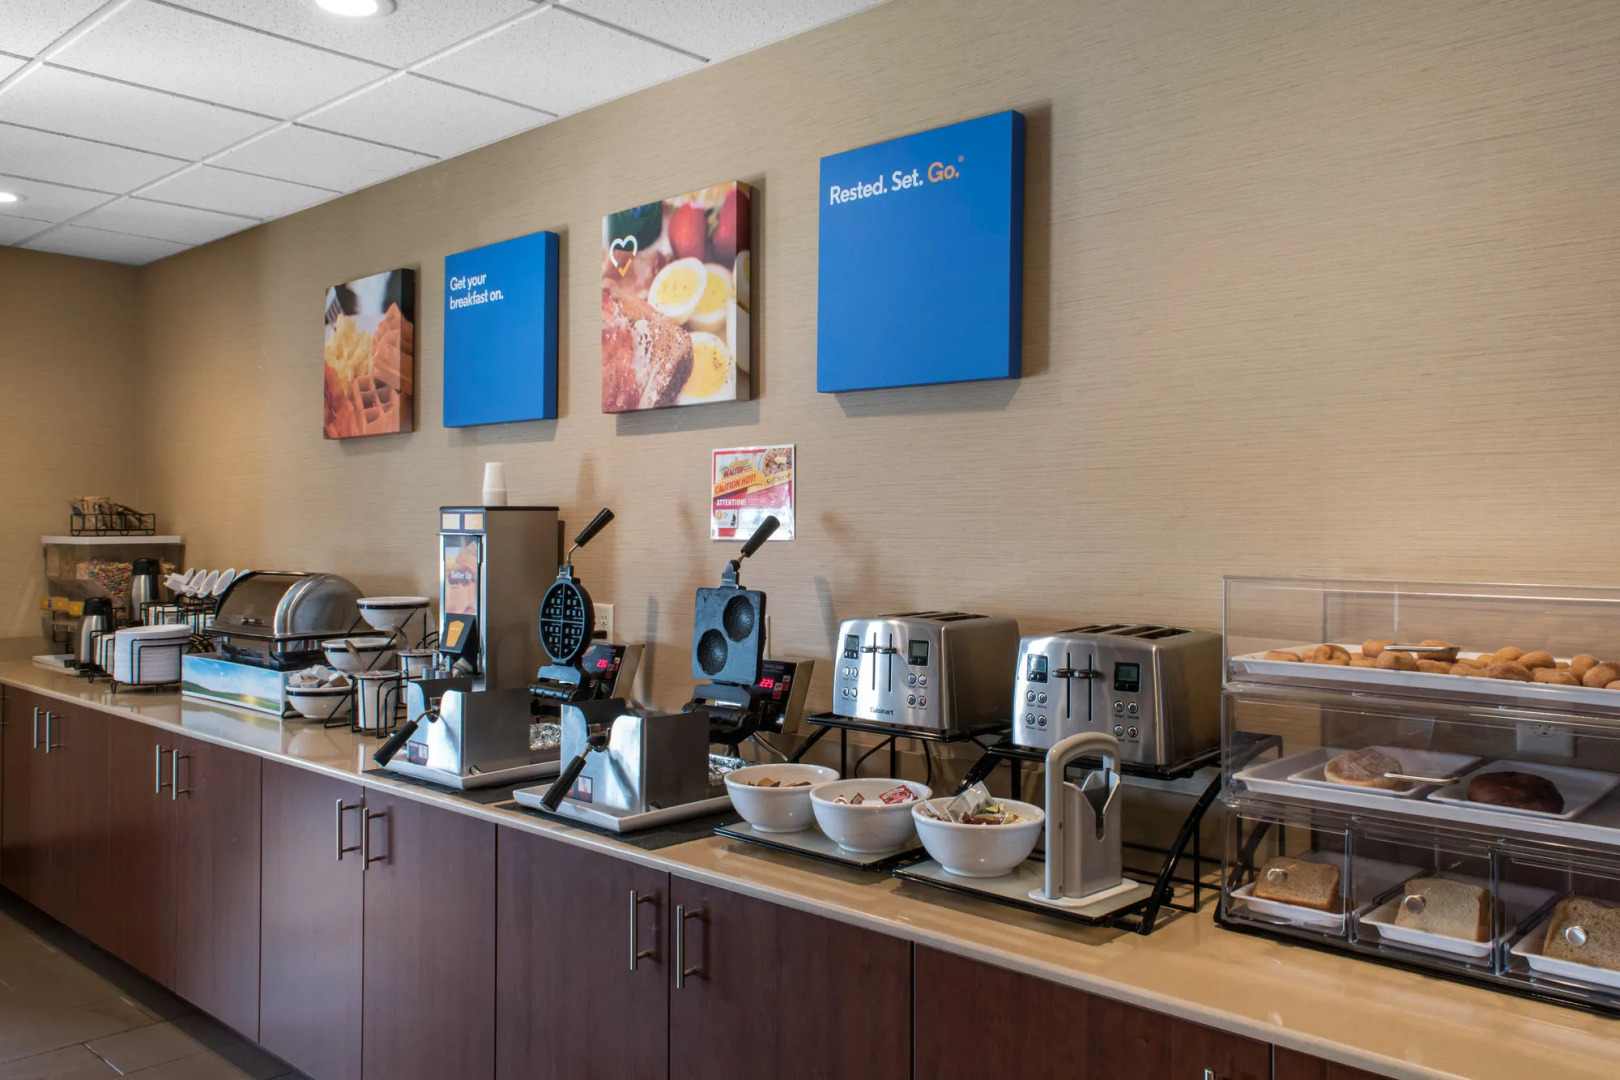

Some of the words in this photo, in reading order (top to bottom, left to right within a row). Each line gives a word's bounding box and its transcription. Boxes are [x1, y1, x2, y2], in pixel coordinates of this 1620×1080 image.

[829, 174, 887, 205] Rested.
[891, 168, 924, 191] Set.
[450, 276, 466, 291] Get
[467, 274, 487, 290] your
[450, 290, 488, 309] breakfast
[490, 289, 504, 302] on.
[714, 479, 741, 494] CAUTION
[741, 473, 757, 486] HOT!
[716, 498, 747, 507] ATTENTION!
[465, 571, 473, 581] Up
[870, 706, 894, 716] Cuisinart
